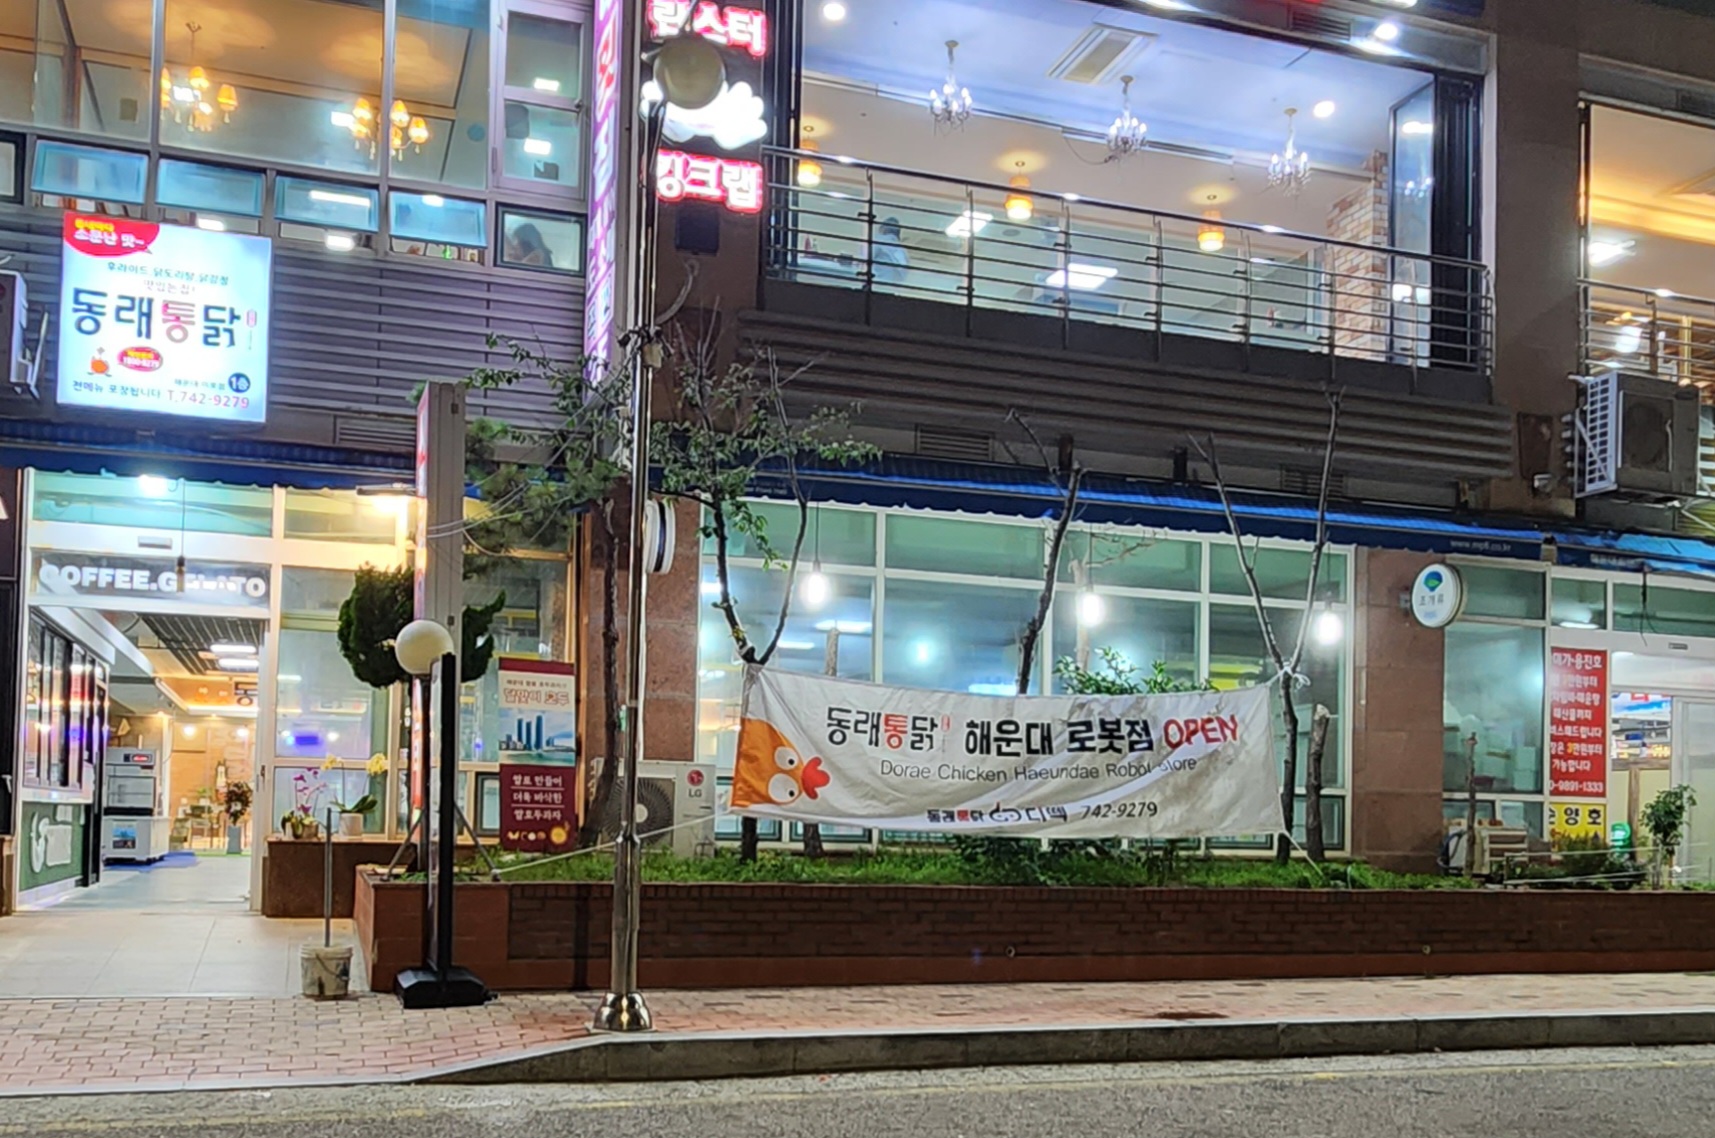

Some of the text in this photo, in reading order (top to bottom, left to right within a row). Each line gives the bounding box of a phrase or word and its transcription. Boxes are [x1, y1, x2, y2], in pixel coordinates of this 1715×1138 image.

[657, 148, 762, 213] 킹크랩
[73, 229, 118, 246] 소문난
[71, 287, 242, 348] 동래통닭
[73, 380, 250, 409] 전메뉴 포장됩니다 T.742-9279
[826, 706, 939, 752] 동래통닭
[965, 718, 1054, 757] 해운대
[1066, 717, 1154, 755] 로봇점
[1162, 714, 1239, 750] OPEN
[880, 759, 931, 779] Dorae
[937, 763, 1007, 782] Chicken
[1014, 762, 1099, 781] Haeundae
[1552, 759, 1592, 773] 가능합니다
[512, 774, 562, 787] 쌀로 만들어
[512, 791, 562, 804] 더욱 바삭한
[688, 789, 702, 798] LG
[1080, 801, 1158, 819] 742-9279
